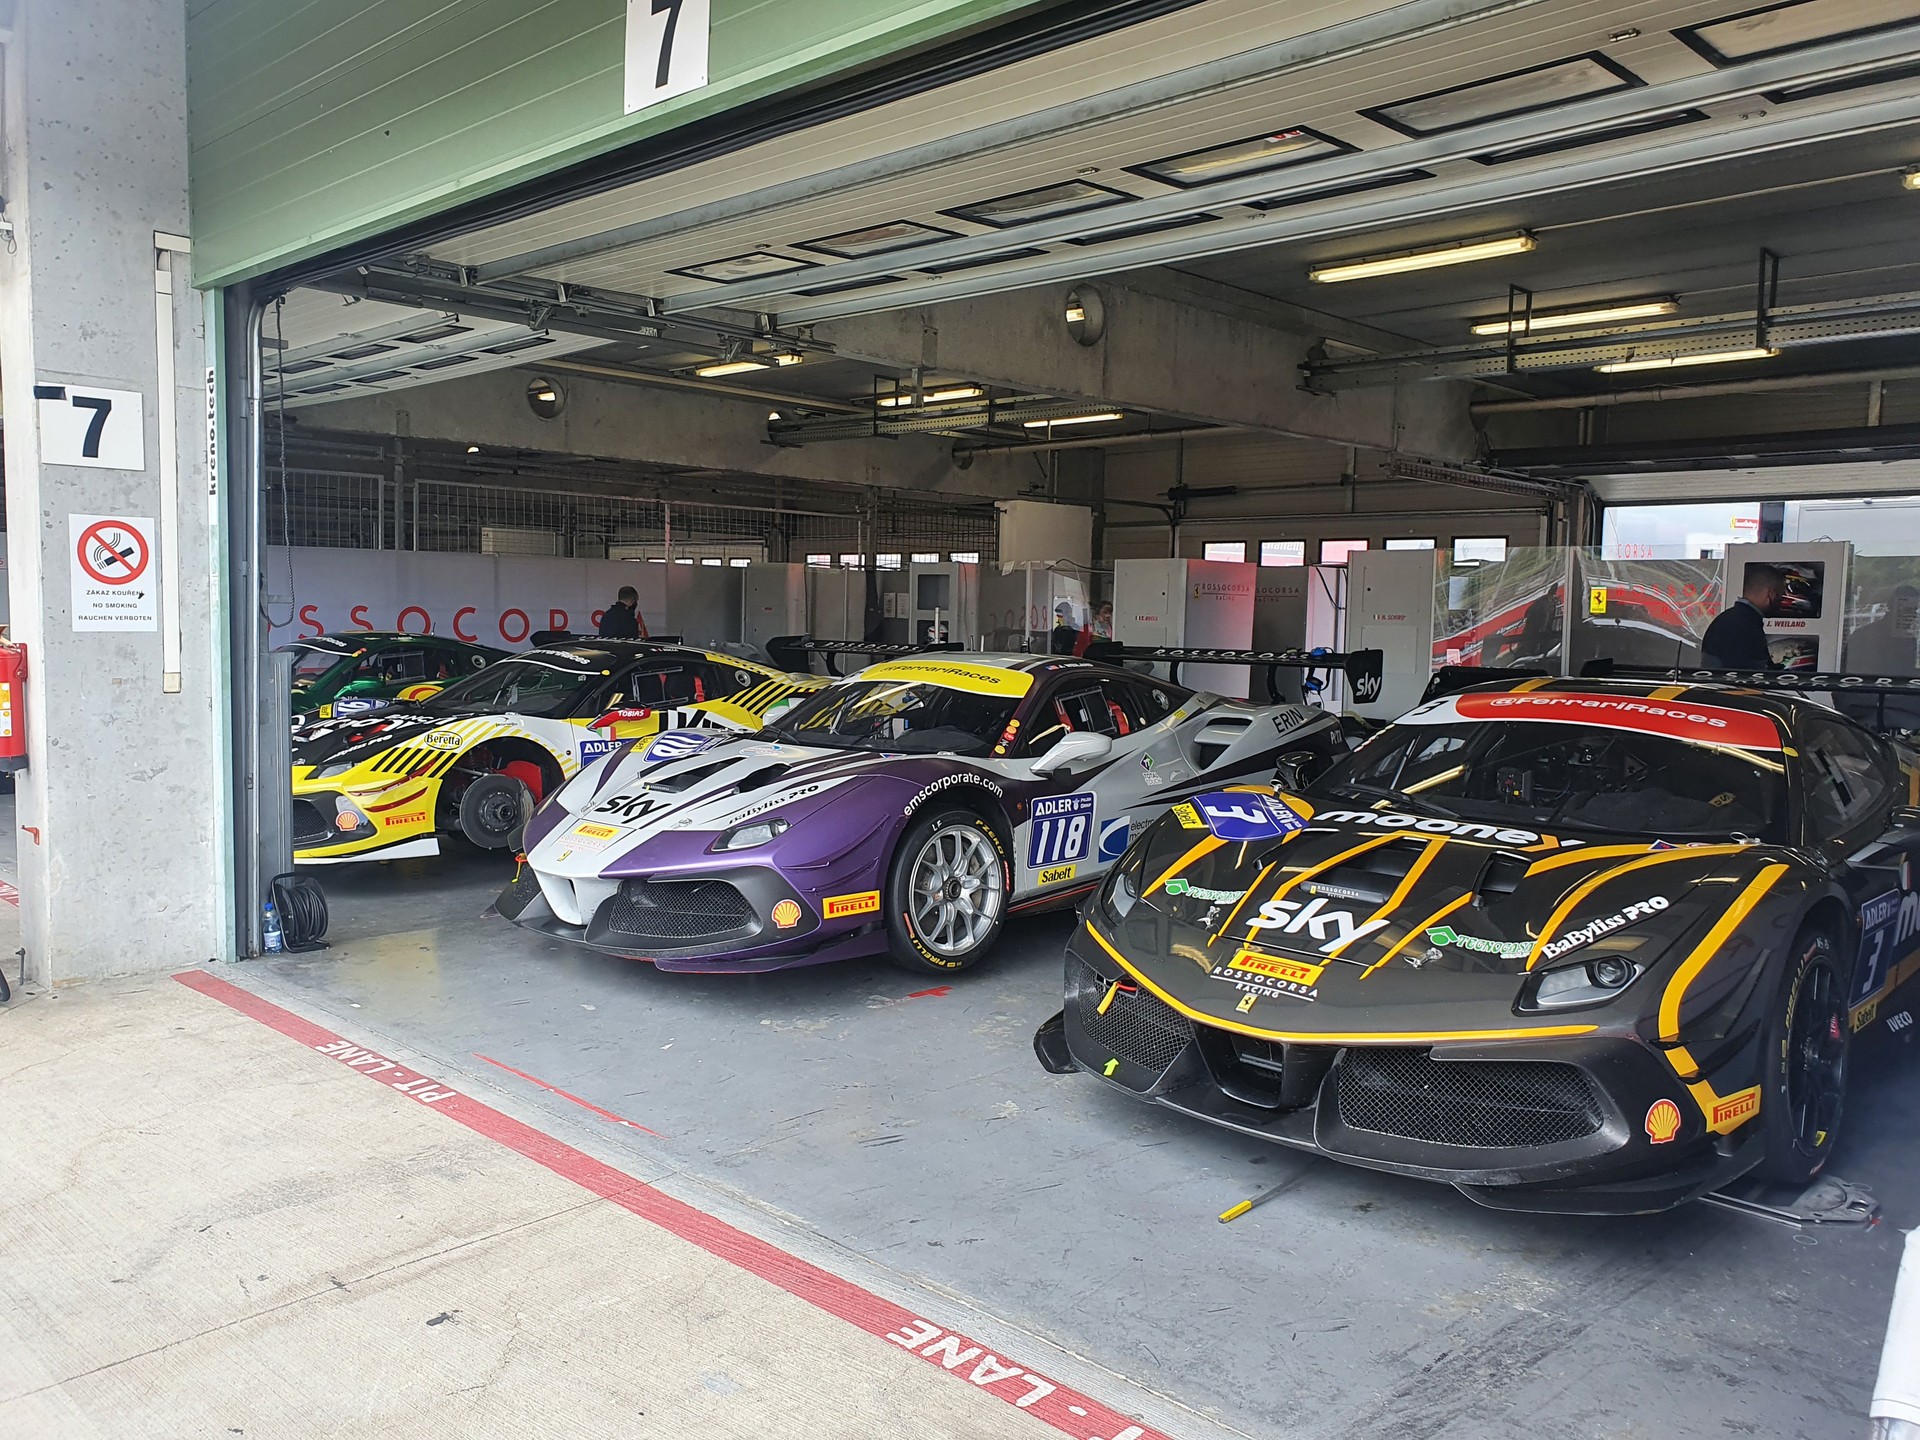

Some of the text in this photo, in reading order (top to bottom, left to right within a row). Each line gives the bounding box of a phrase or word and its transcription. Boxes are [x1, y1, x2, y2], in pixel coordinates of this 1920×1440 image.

[650, 0, 684, 89] 7
[72, 395, 112, 459] 7
[207, 370, 216, 496] kreno.tech
[1617, 543, 1653, 559] CORSA
[1202, 583, 1250, 593] ROSSOCORSA
[1616, 583, 1724, 598] ROSSOC
[1766, 620, 1773, 628] J.
[1356, 672, 1382, 699] sky
[618, 709, 645, 717] TOBIAS
[1271, 707, 1305, 733] ERIN
[1490, 697, 1728, 728] @FerrariRaces
[426, 734, 460, 746] Beretta
[788, 785, 819, 799] PRO
[903, 772, 1004, 816] emscorporate.com
[594, 792, 672, 825] sky
[1035, 798, 1072, 816] ADLER
[1204, 805, 1268, 824] 3
[386, 812, 426, 826] PIRELLI
[578, 825, 613, 838] PIRELLI
[1036, 815, 1086, 864] 118
[1042, 867, 1072, 883] Sabelt
[1317, 885, 1360, 897] ROSSOCORSA
[829, 896, 875, 914] PIRELLI
[1865, 902, 1887, 930] ADLER
[1246, 898, 1391, 953] sky
[1541, 896, 1669, 960] BaByliss PRO
[1239, 955, 1311, 979] PIRELLI
[1862, 929, 1884, 995] 3
[1213, 966, 1318, 998] ROSSOCORSA
[1235, 982, 1280, 999] RACING
[1886, 1010, 1913, 1033] IVECO
[1712, 1093, 1756, 1125] PIRELLI
